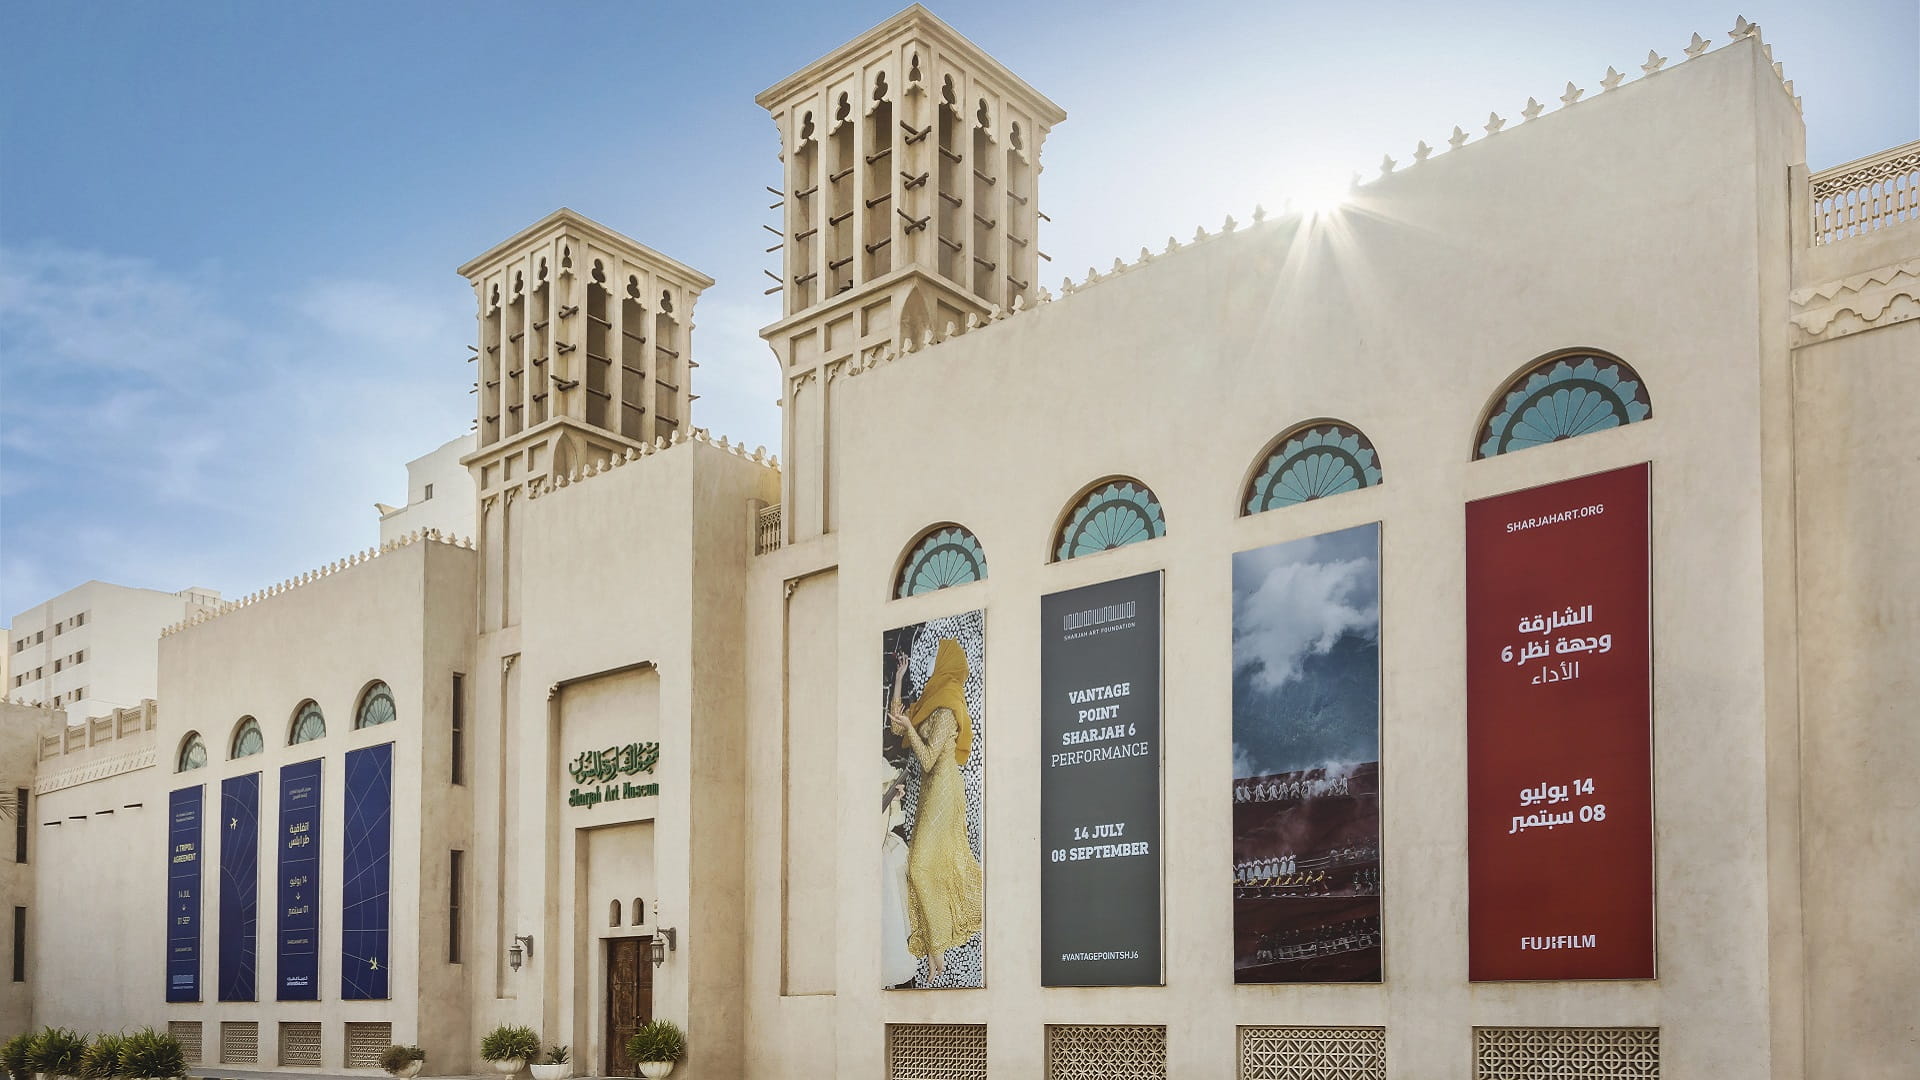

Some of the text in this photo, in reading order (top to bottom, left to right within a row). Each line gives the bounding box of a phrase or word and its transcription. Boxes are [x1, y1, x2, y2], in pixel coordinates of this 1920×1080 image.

[1506, 503, 1604, 533] SHARJAHART.ORG
[1063, 621, 1136, 642] SHARJAH ART FOUNDATION
[1518, 604, 1593, 635] الشارقة
[1501, 633, 1612, 666] وجهة نظر 6
[1531, 660, 1580, 685] الأداء
[1068, 682, 1131, 705] VANTAGE
[1078, 704, 1120, 724] POINT
[1062, 722, 1136, 746] SHARJAH 6
[1051, 741, 1149, 768] PERFORMANCE
[569, 785, 602, 810] Sharjah
[604, 784, 620, 802] Art
[1519, 777, 1595, 807] 14 يوليو
[1508, 804, 1606, 835] 08 سبتمبر
[1073, 823, 1125, 841] 14 JULY
[1051, 841, 1149, 863] 08 SEPTEMBER
[1521, 934, 1596, 950] FUJIFILM
[1062, 950, 1139, 962] #VANTAGEPOINTSHJ6
